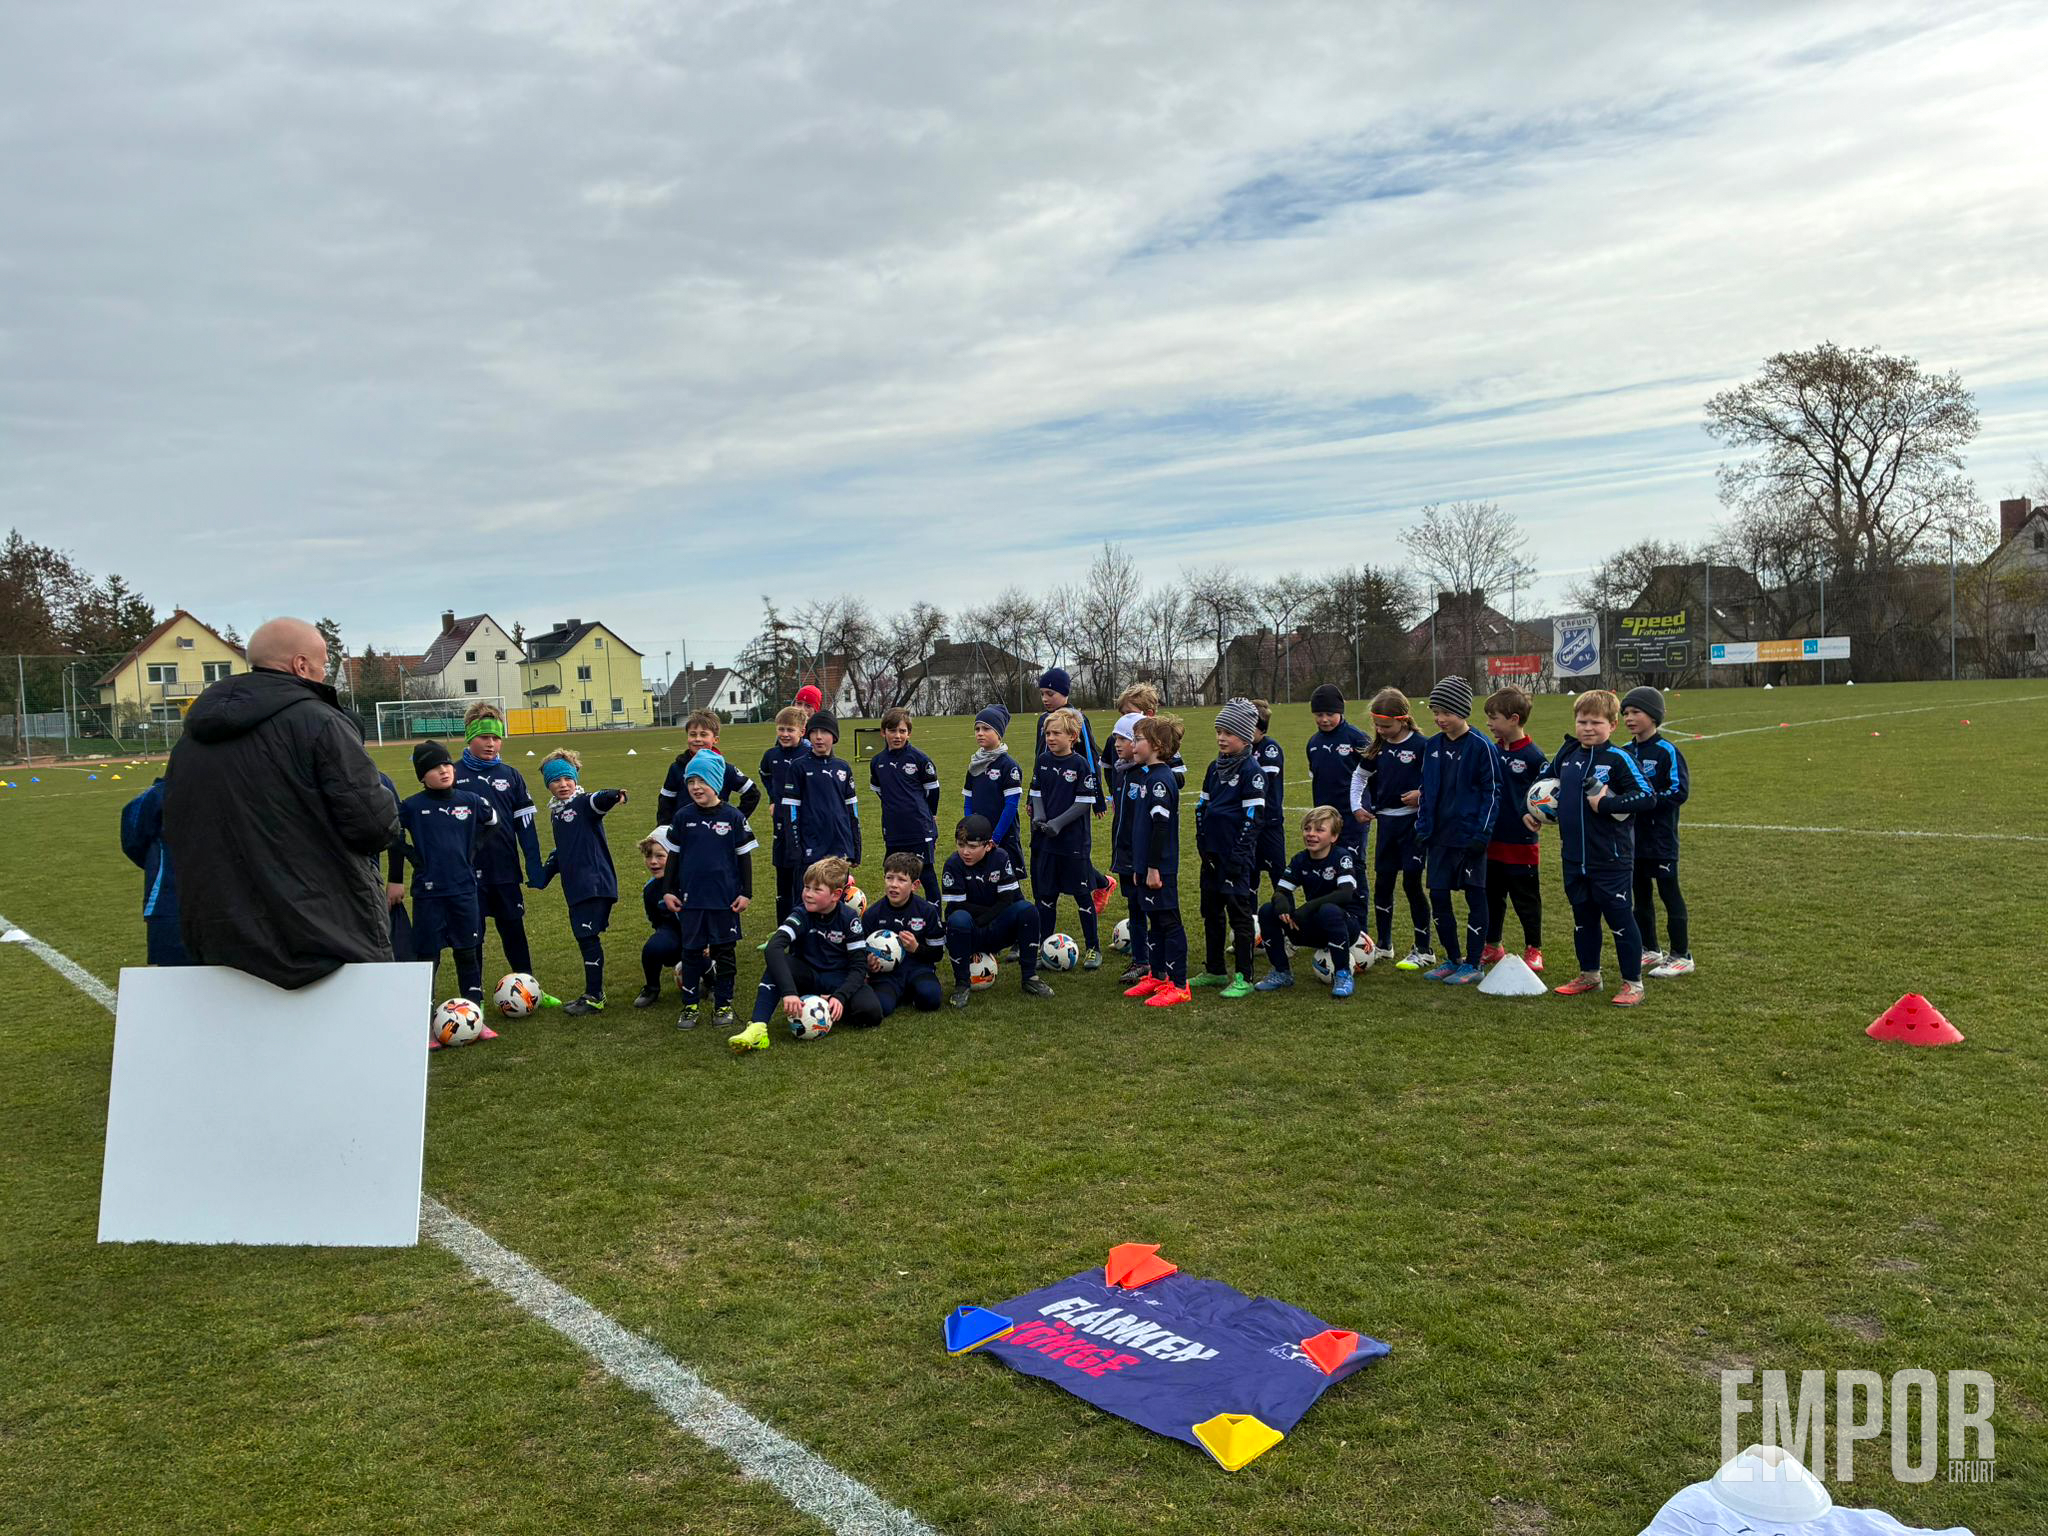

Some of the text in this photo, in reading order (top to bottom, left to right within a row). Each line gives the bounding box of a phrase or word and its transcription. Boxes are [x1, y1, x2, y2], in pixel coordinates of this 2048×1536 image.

[1561, 618, 1592, 628] ERFURT
[1621, 610, 1686, 636] speed
[1638, 627, 1686, 636] Fahrschule
[1037, 1296, 1220, 1362] FLANKEN
